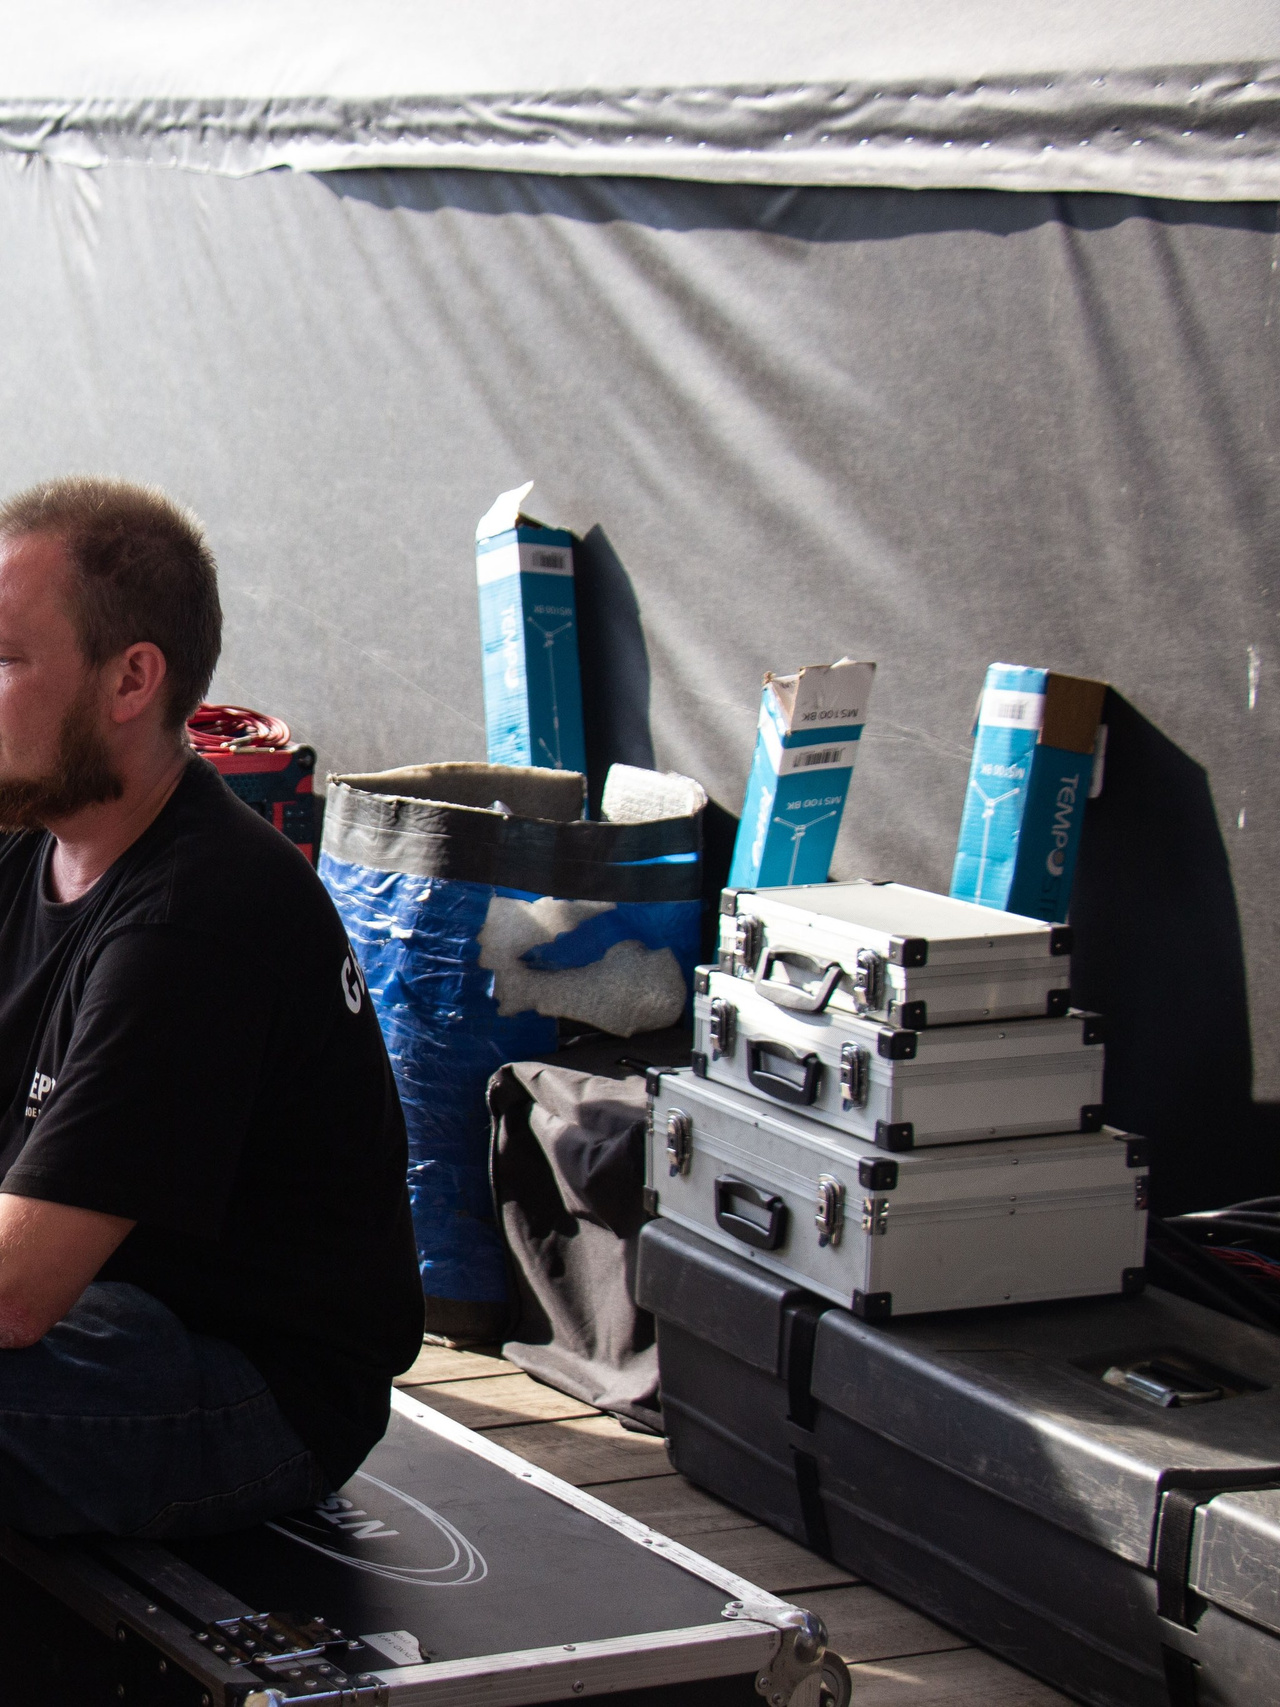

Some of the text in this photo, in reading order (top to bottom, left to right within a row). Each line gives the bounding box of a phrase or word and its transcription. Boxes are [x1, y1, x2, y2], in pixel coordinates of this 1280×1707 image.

[801, 708, 859, 721] MS100 BK
[786, 796, 842, 810] MS100 BK
[1045, 773, 1080, 877] TEMPO
